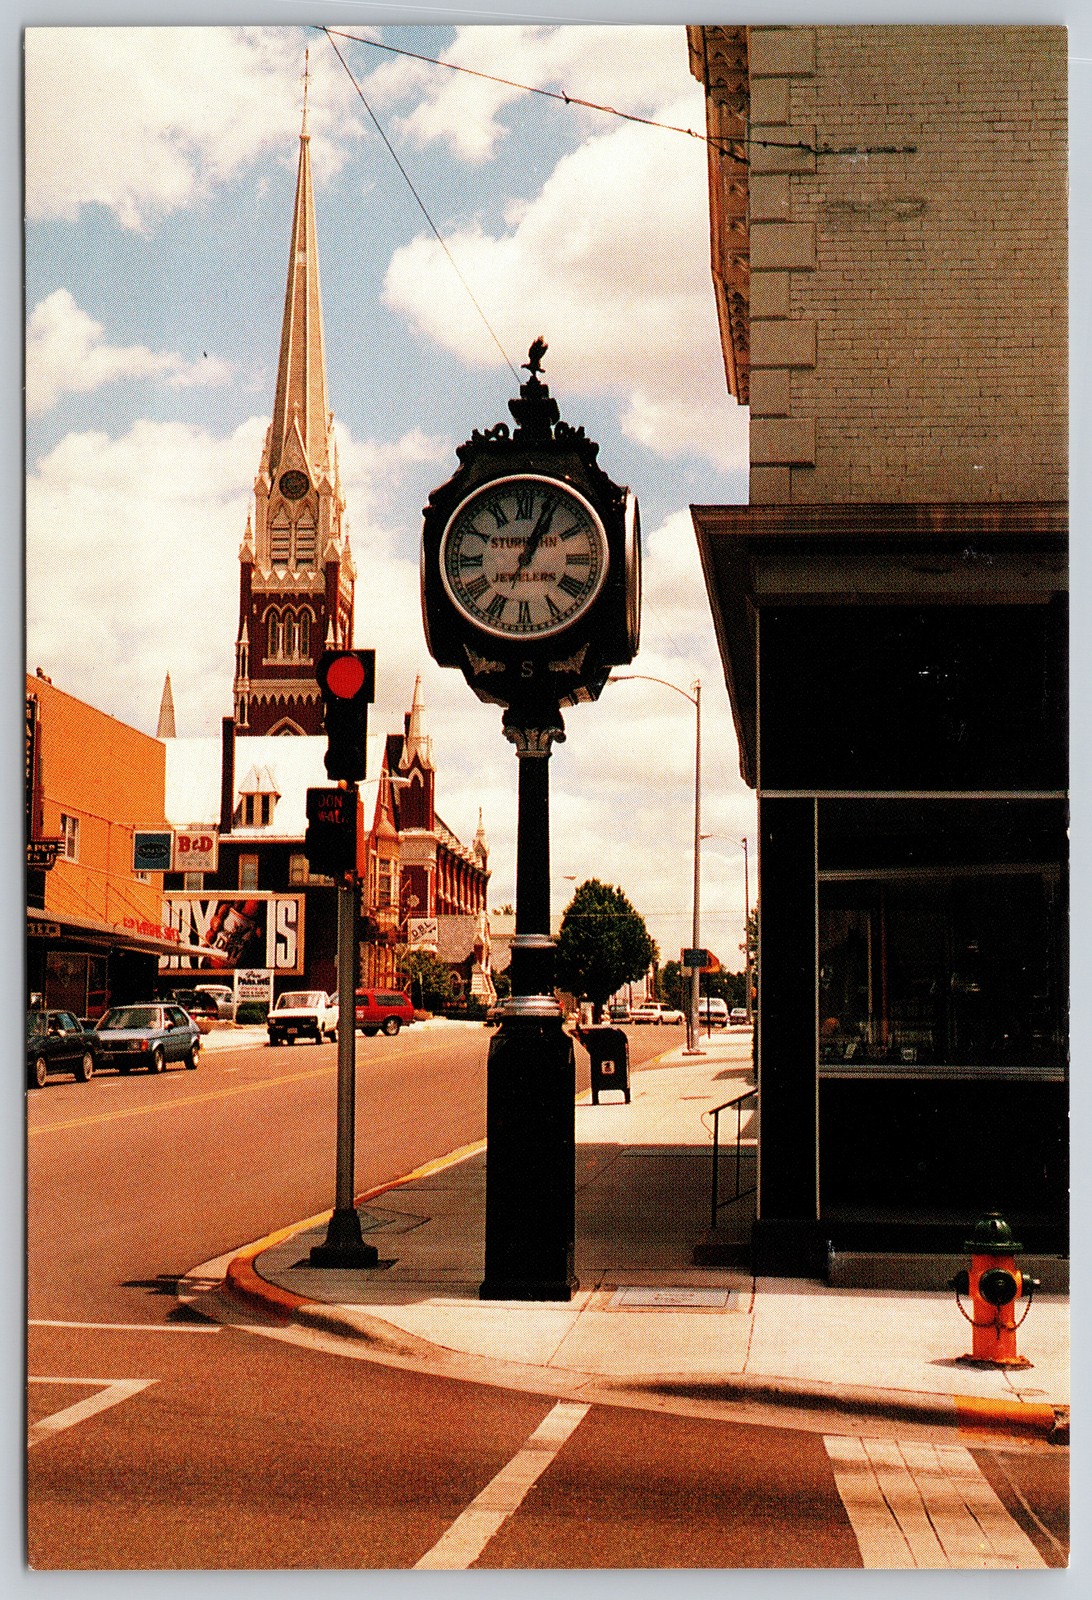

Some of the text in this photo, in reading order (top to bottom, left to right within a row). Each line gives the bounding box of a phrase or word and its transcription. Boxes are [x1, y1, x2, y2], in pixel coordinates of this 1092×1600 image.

[490, 535, 558, 549] STURHN
[491, 572, 556, 582] JEWELERS
[521, 660, 533, 677] S
[266, 900, 297, 968] IS
